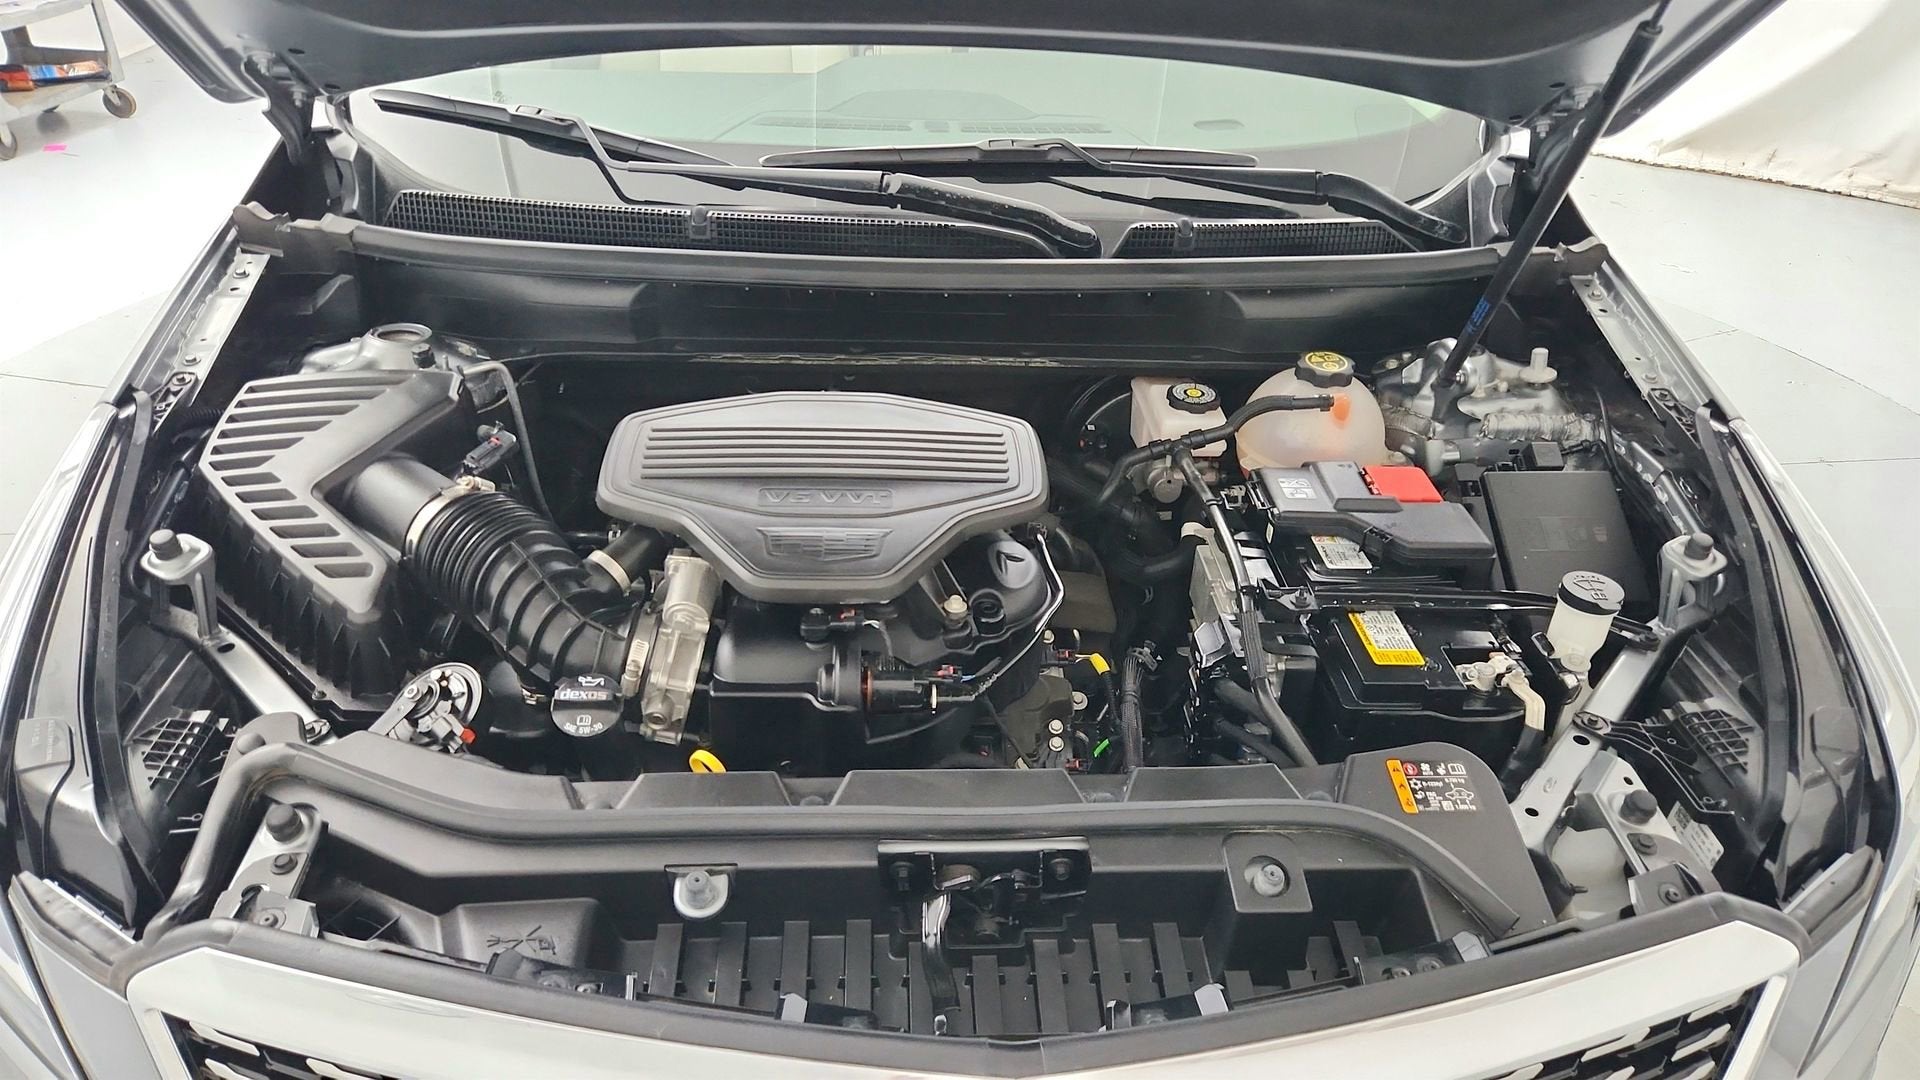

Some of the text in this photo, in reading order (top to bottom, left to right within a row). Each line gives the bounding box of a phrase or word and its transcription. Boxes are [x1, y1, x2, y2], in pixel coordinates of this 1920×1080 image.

[560, 688, 608, 700] dexos
[564, 722, 603, 734] SAE 5W-30
